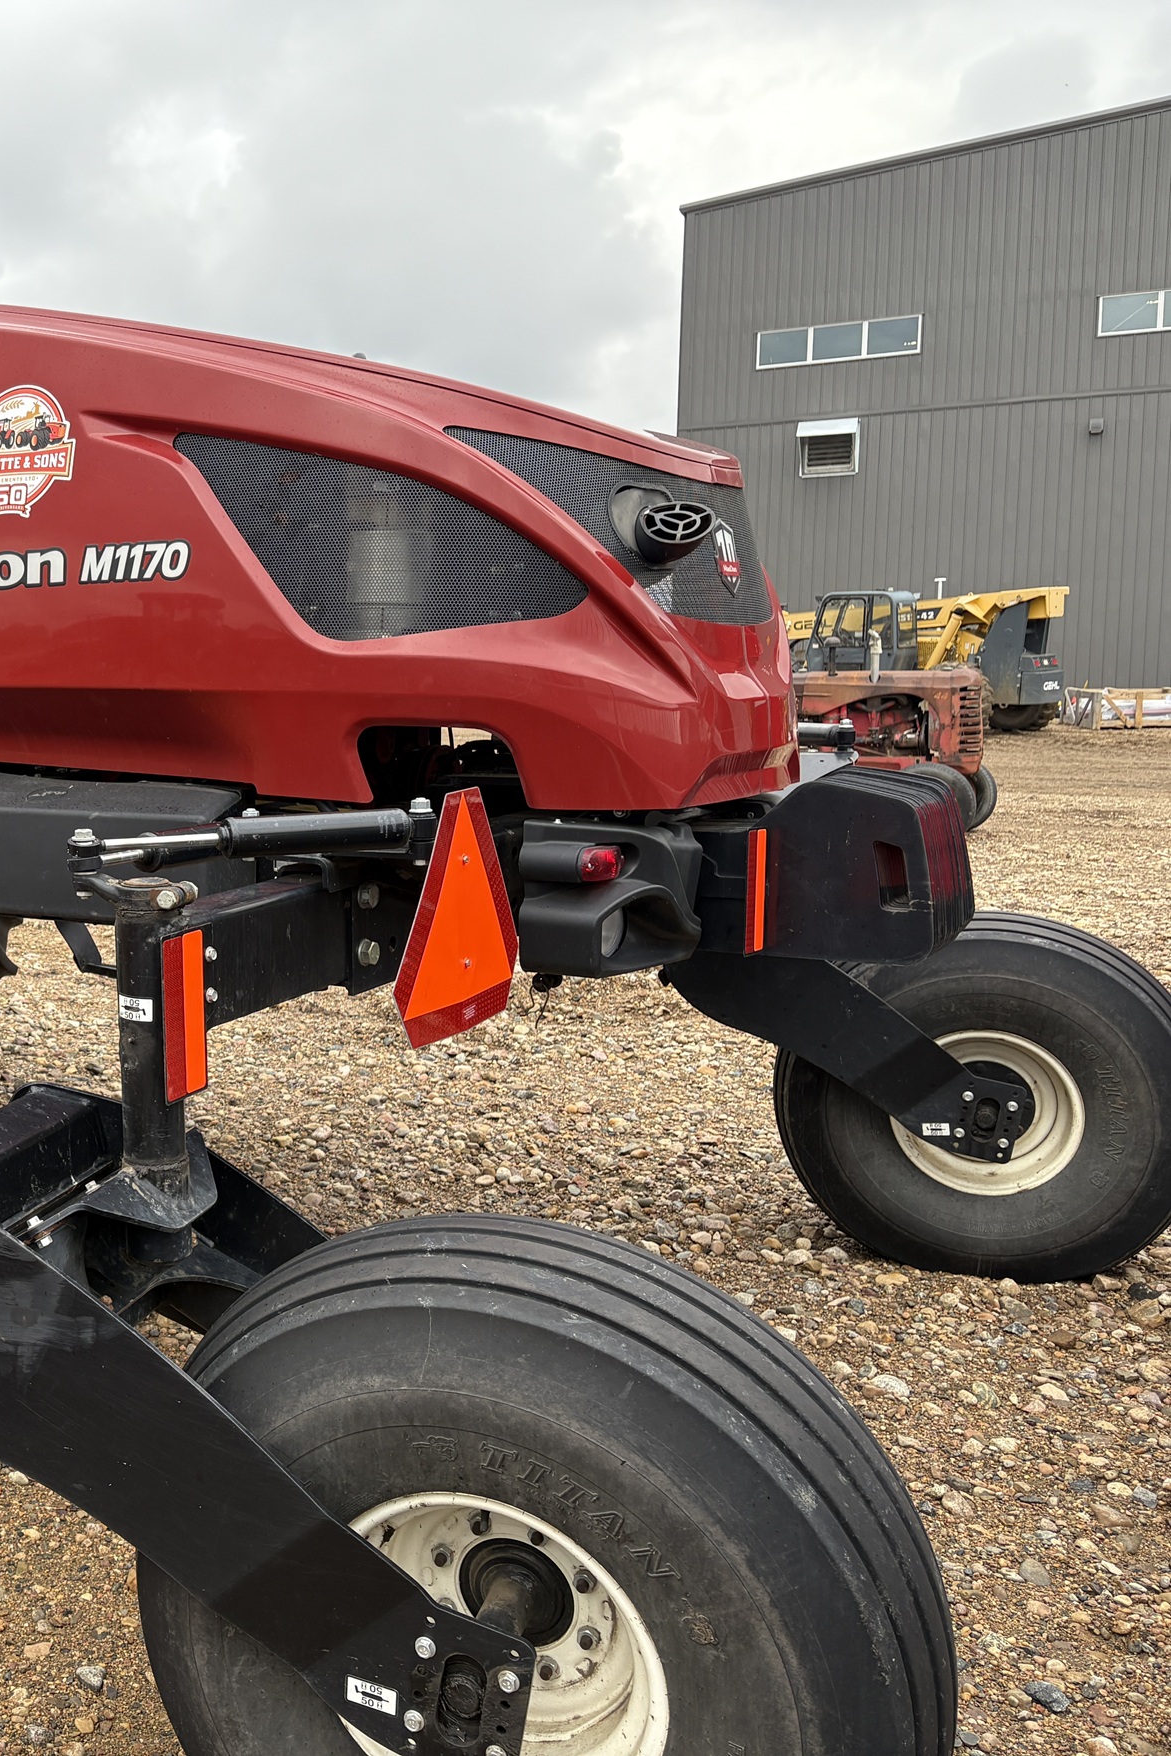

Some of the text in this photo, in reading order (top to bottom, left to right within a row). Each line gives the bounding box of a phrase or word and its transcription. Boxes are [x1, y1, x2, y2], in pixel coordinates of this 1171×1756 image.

[23, 456, 30, 468] &
[34, 452, 66, 467] SONS
[79, 540, 190, 583] M1170
[1043, 681, 1060, 691] GEHL
[1094, 1064, 1130, 1164] TITAN
[478, 1440, 682, 1581] TITAN
[369, 1684, 383, 1695] 50
[360, 1696, 375, 1707] 50
